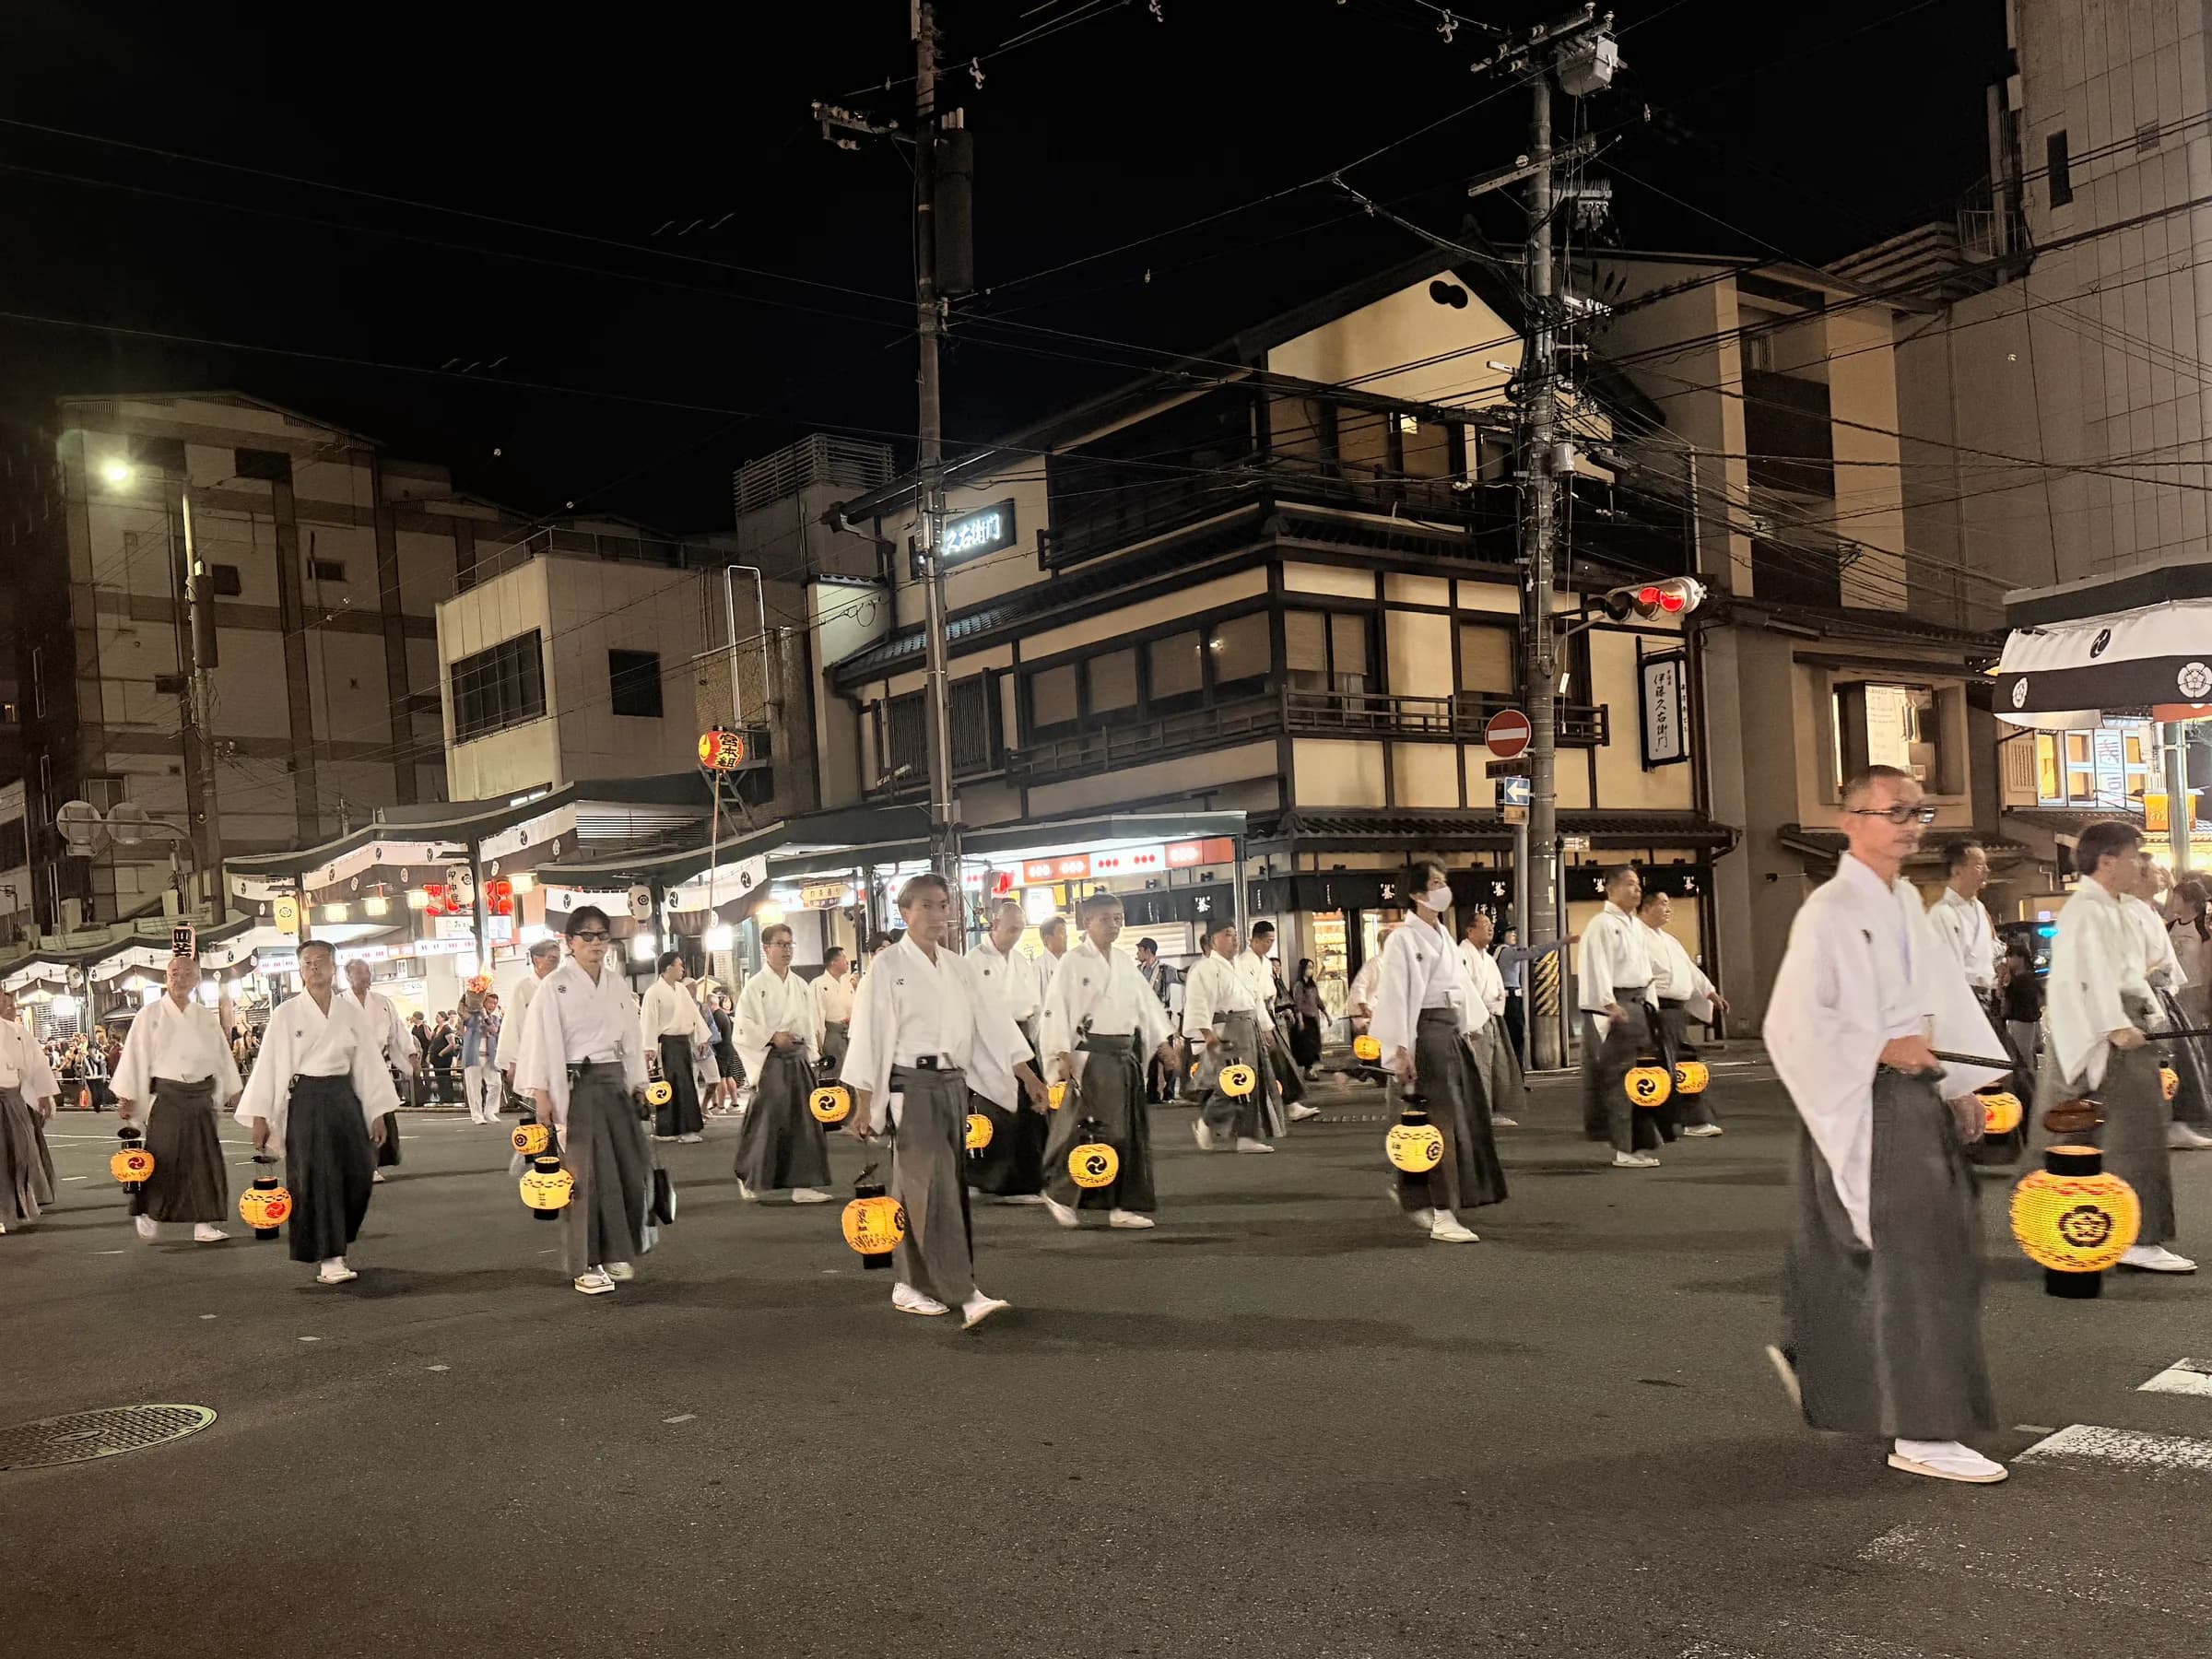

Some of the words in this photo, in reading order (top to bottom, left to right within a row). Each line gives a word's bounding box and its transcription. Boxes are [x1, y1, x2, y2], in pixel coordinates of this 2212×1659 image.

[1653, 672, 1668, 753] 伊藤久右衛門
[719, 734, 738, 767] 宮本組
